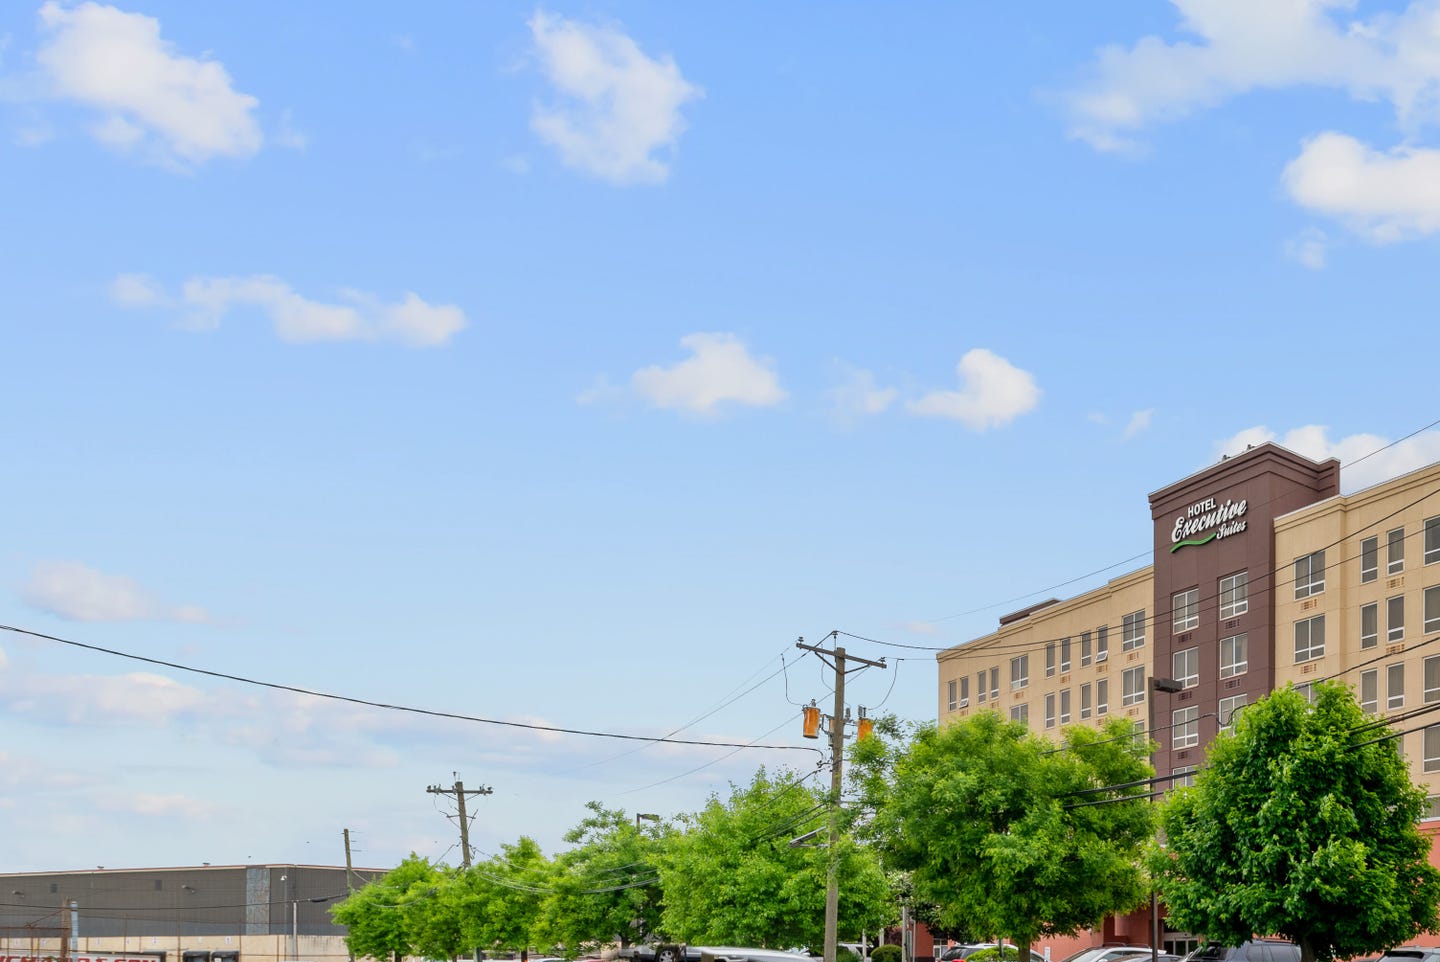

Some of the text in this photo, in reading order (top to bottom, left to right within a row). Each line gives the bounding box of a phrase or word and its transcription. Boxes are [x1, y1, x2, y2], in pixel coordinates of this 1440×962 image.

[1187, 497, 1217, 518] HOTEL
[1171, 499, 1248, 543] Executive
[1216, 520, 1248, 540] Suites
